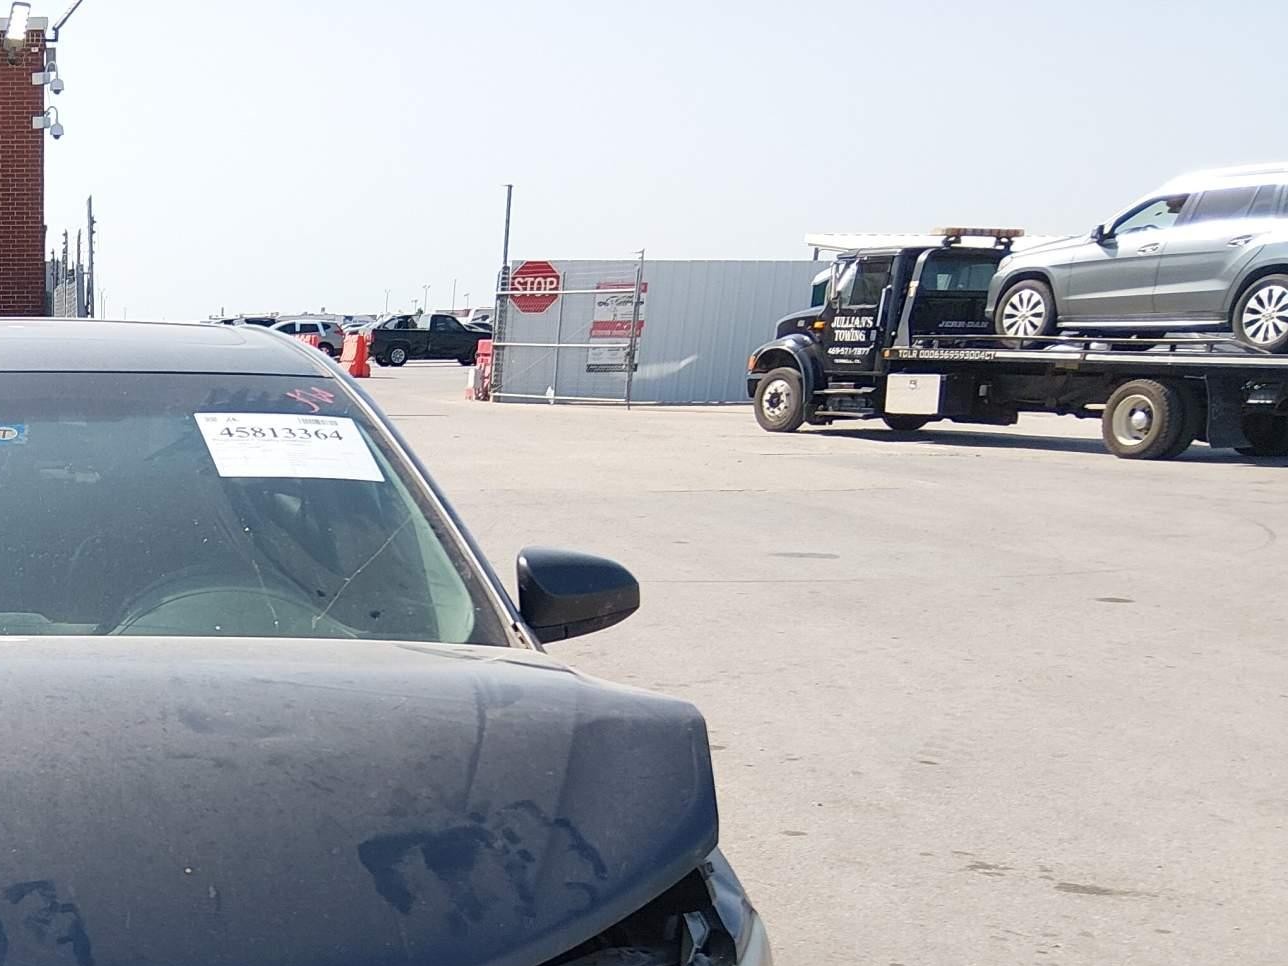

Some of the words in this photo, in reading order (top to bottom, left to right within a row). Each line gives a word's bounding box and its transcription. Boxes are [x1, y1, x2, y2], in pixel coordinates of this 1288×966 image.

[514, 277, 558, 297] STOP
[834, 329, 866, 341] TOWING
[219, 426, 344, 441] 45813364
